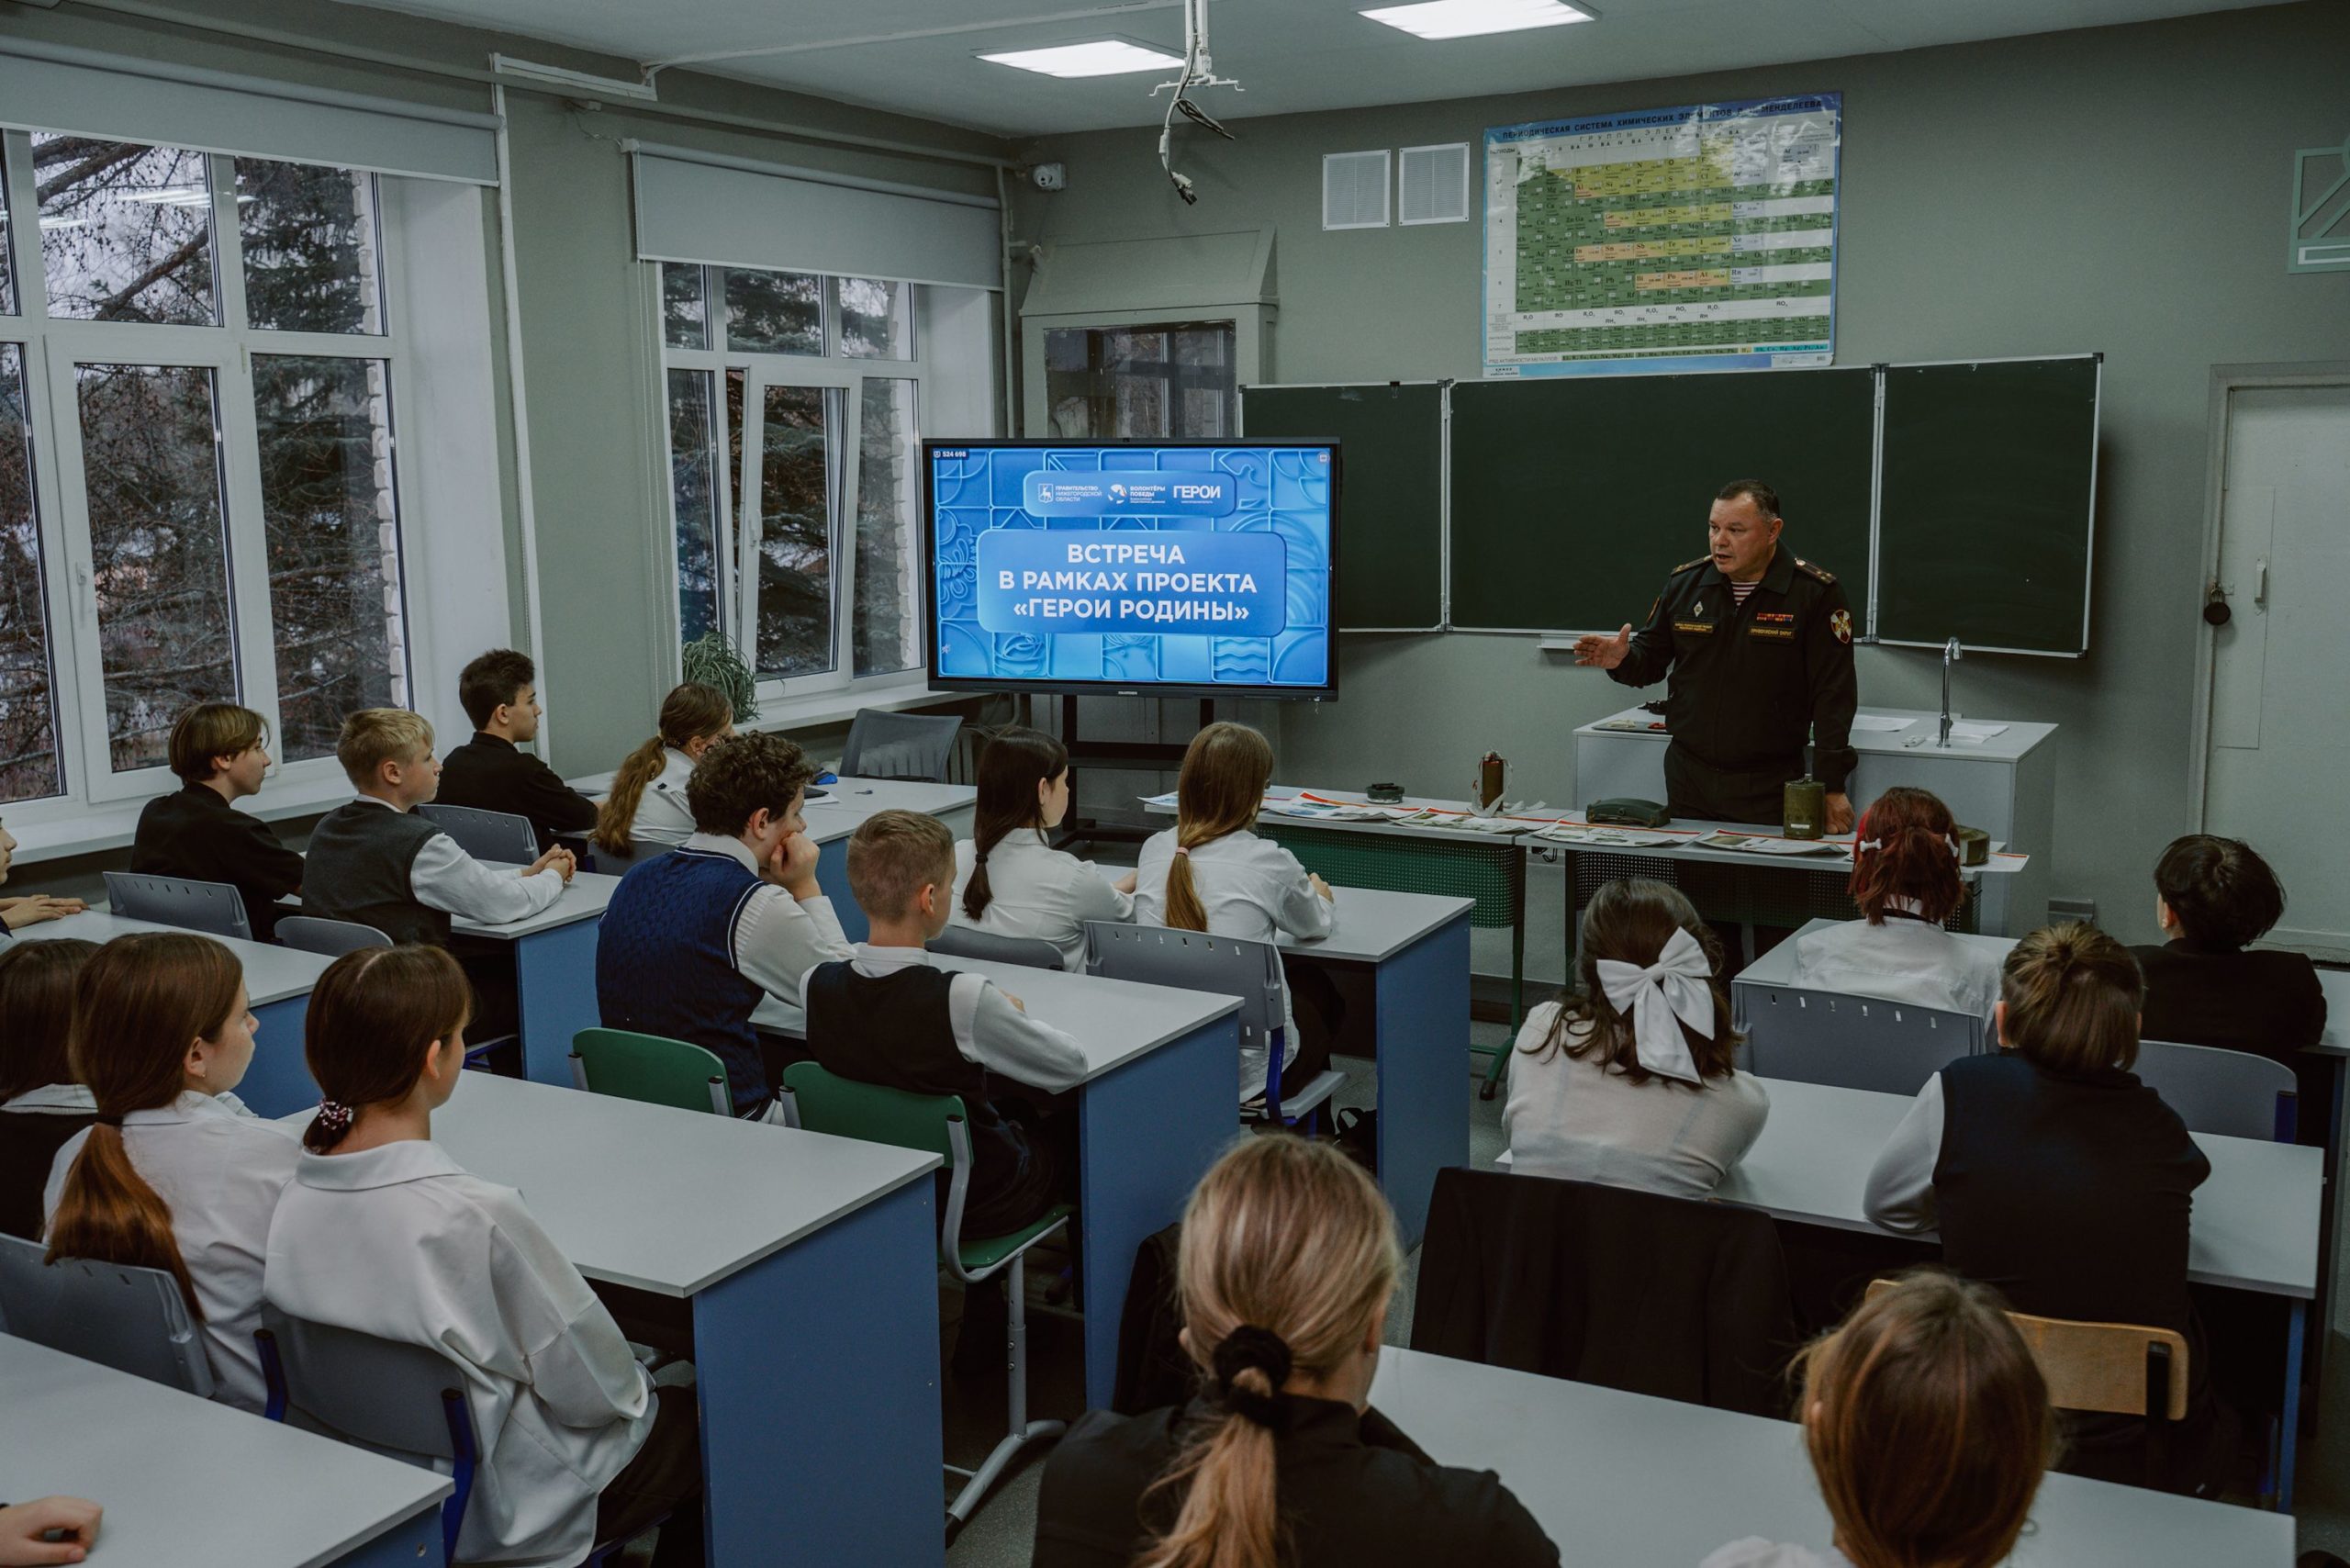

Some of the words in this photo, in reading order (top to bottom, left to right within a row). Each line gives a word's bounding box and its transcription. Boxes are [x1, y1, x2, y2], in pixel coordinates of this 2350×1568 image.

[1503, 124, 1571, 140] ПЕРИОДИЧЕСКАЯ
[1574, 120, 1613, 132] СИСТЕМА
[1617, 114, 1674, 127] ХИМИЧЕСКИХ
[1761, 99, 1822, 114] МЕНДЕЛЕЕВА
[1173, 485, 1221, 498] ГЕРОИ
[1068, 543, 1186, 564] ВСТРЕЧА
[999, 571, 1015, 589] В
[1023, 571, 1128, 591] РАМКАХ
[1136, 573, 1258, 593] ПРОЕКТА
[1013, 599, 1111, 619] «ГЕРОИ
[1120, 600, 1249, 622] РОДИНЫ»
